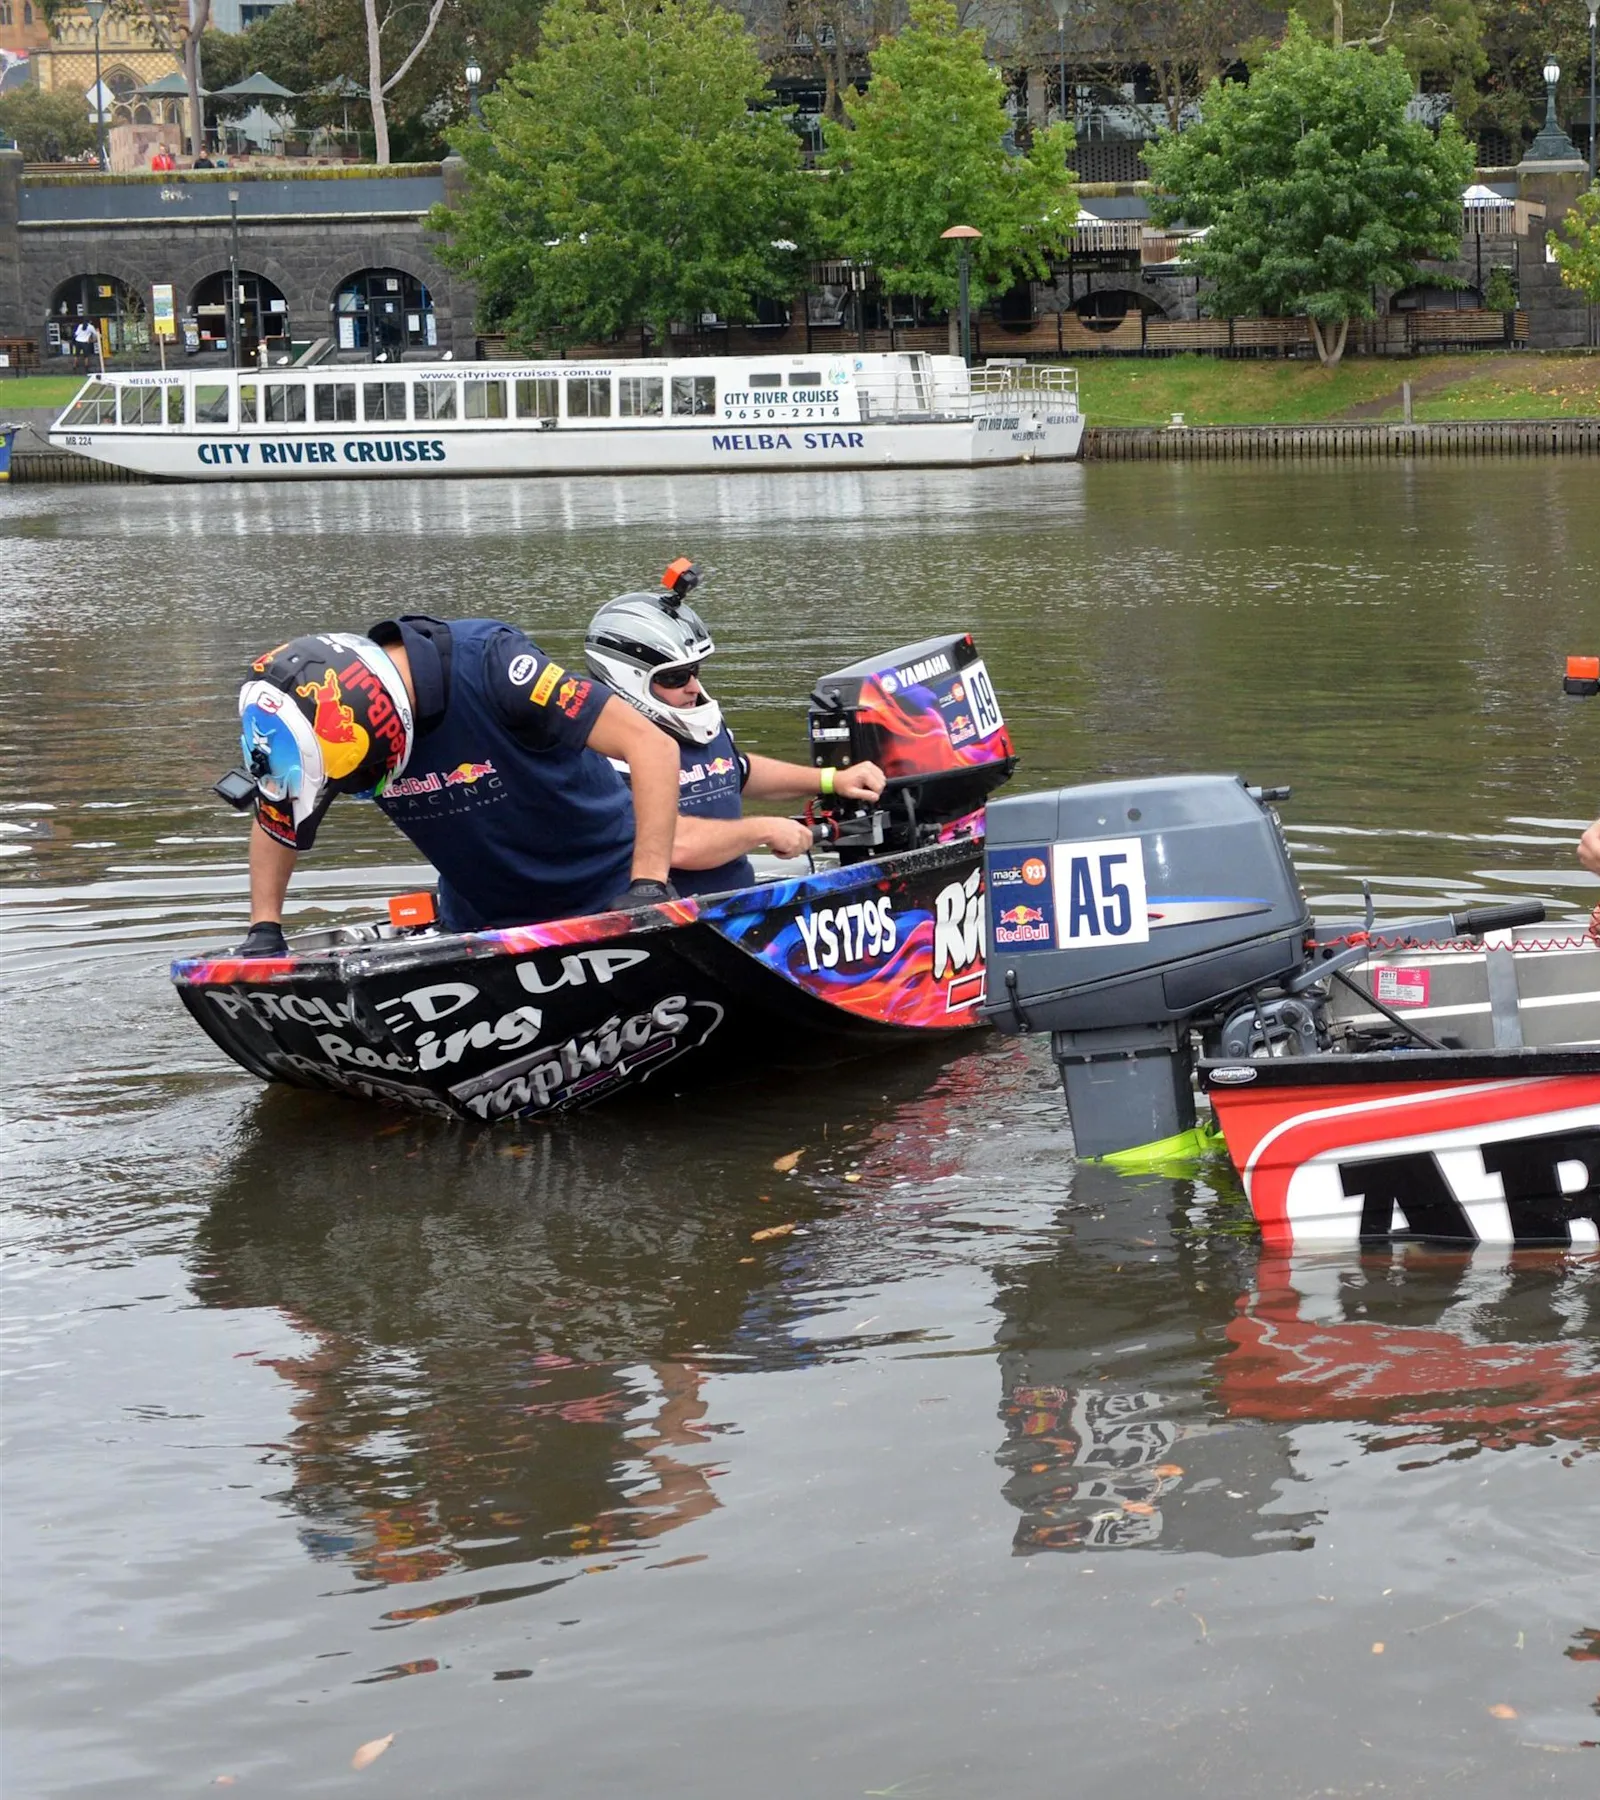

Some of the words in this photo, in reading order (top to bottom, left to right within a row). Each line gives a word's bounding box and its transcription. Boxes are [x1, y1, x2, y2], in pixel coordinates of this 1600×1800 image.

[129, 377, 156, 385] MELBA
[158, 377, 179, 385] STAR
[420, 368, 612, 380] www.cityrivercruises.com.au
[724, 391, 751, 406] CITY
[753, 391, 788, 405] RIVER
[792, 389, 839, 404] CRUISES
[197, 442, 250, 465] CITY
[259, 441, 338, 464] RIVER
[343, 440, 447, 463] CRUISES
[713, 432, 792, 450] MELBA
[804, 432, 864, 449] STAR
[895, 653, 951, 688] YAMAHA
[969, 670, 999, 731] A9
[387, 776, 503, 810] RACING
[992, 866, 1022, 881] magic
[1069, 853, 1132, 938] A5
[795, 896, 897, 971] YS179S
[515, 947, 651, 994] UP
